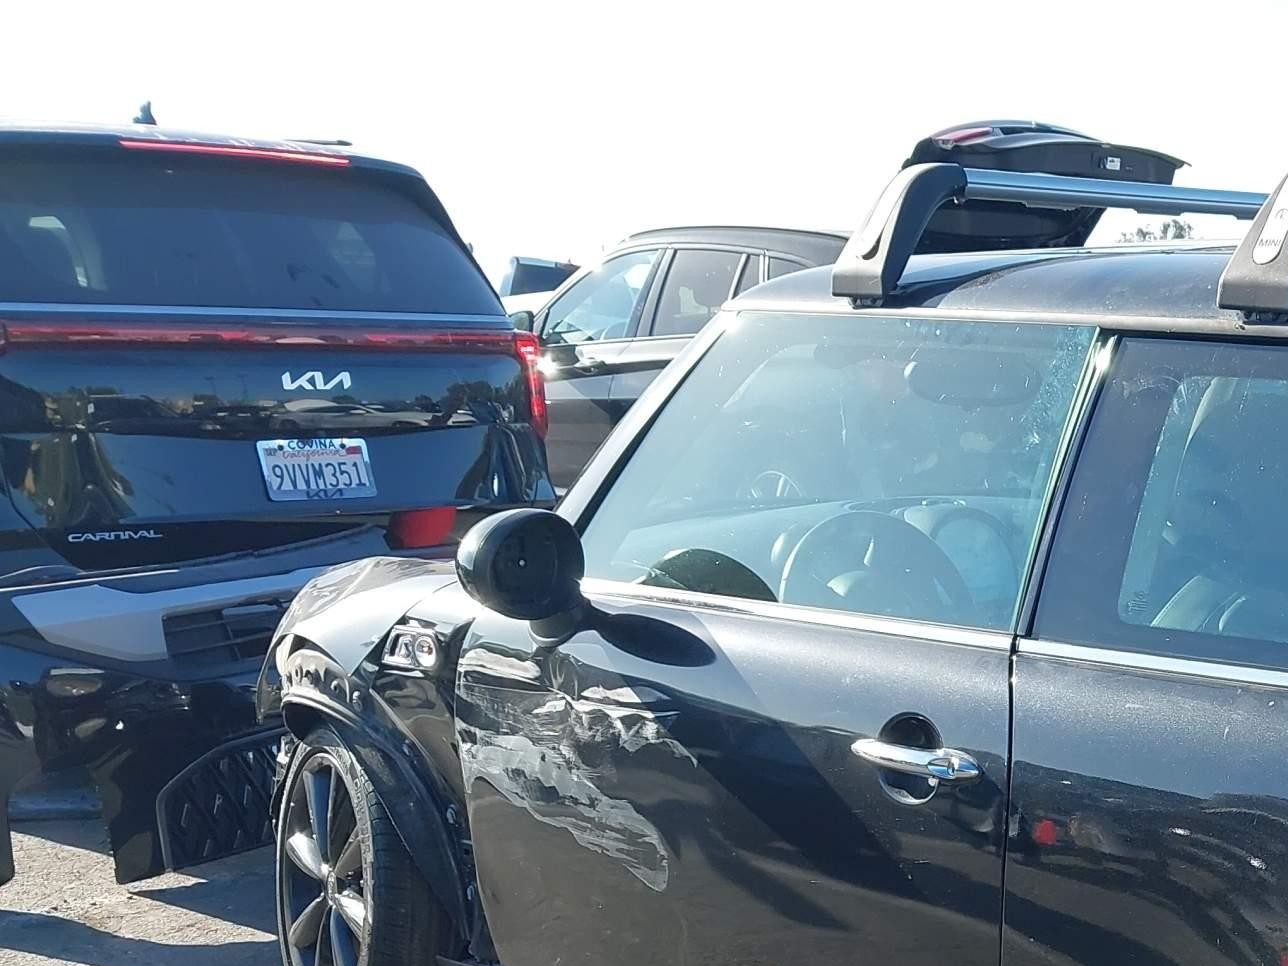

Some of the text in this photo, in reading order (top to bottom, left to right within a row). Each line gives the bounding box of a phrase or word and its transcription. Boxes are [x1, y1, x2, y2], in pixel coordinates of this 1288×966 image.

[1258, 238, 1281, 247] MINI
[281, 371, 352, 390] KIA
[288, 440, 337, 449] COVINA
[272, 462, 367, 490] 9VVM351
[67, 529, 163, 542] CARNIVAL
